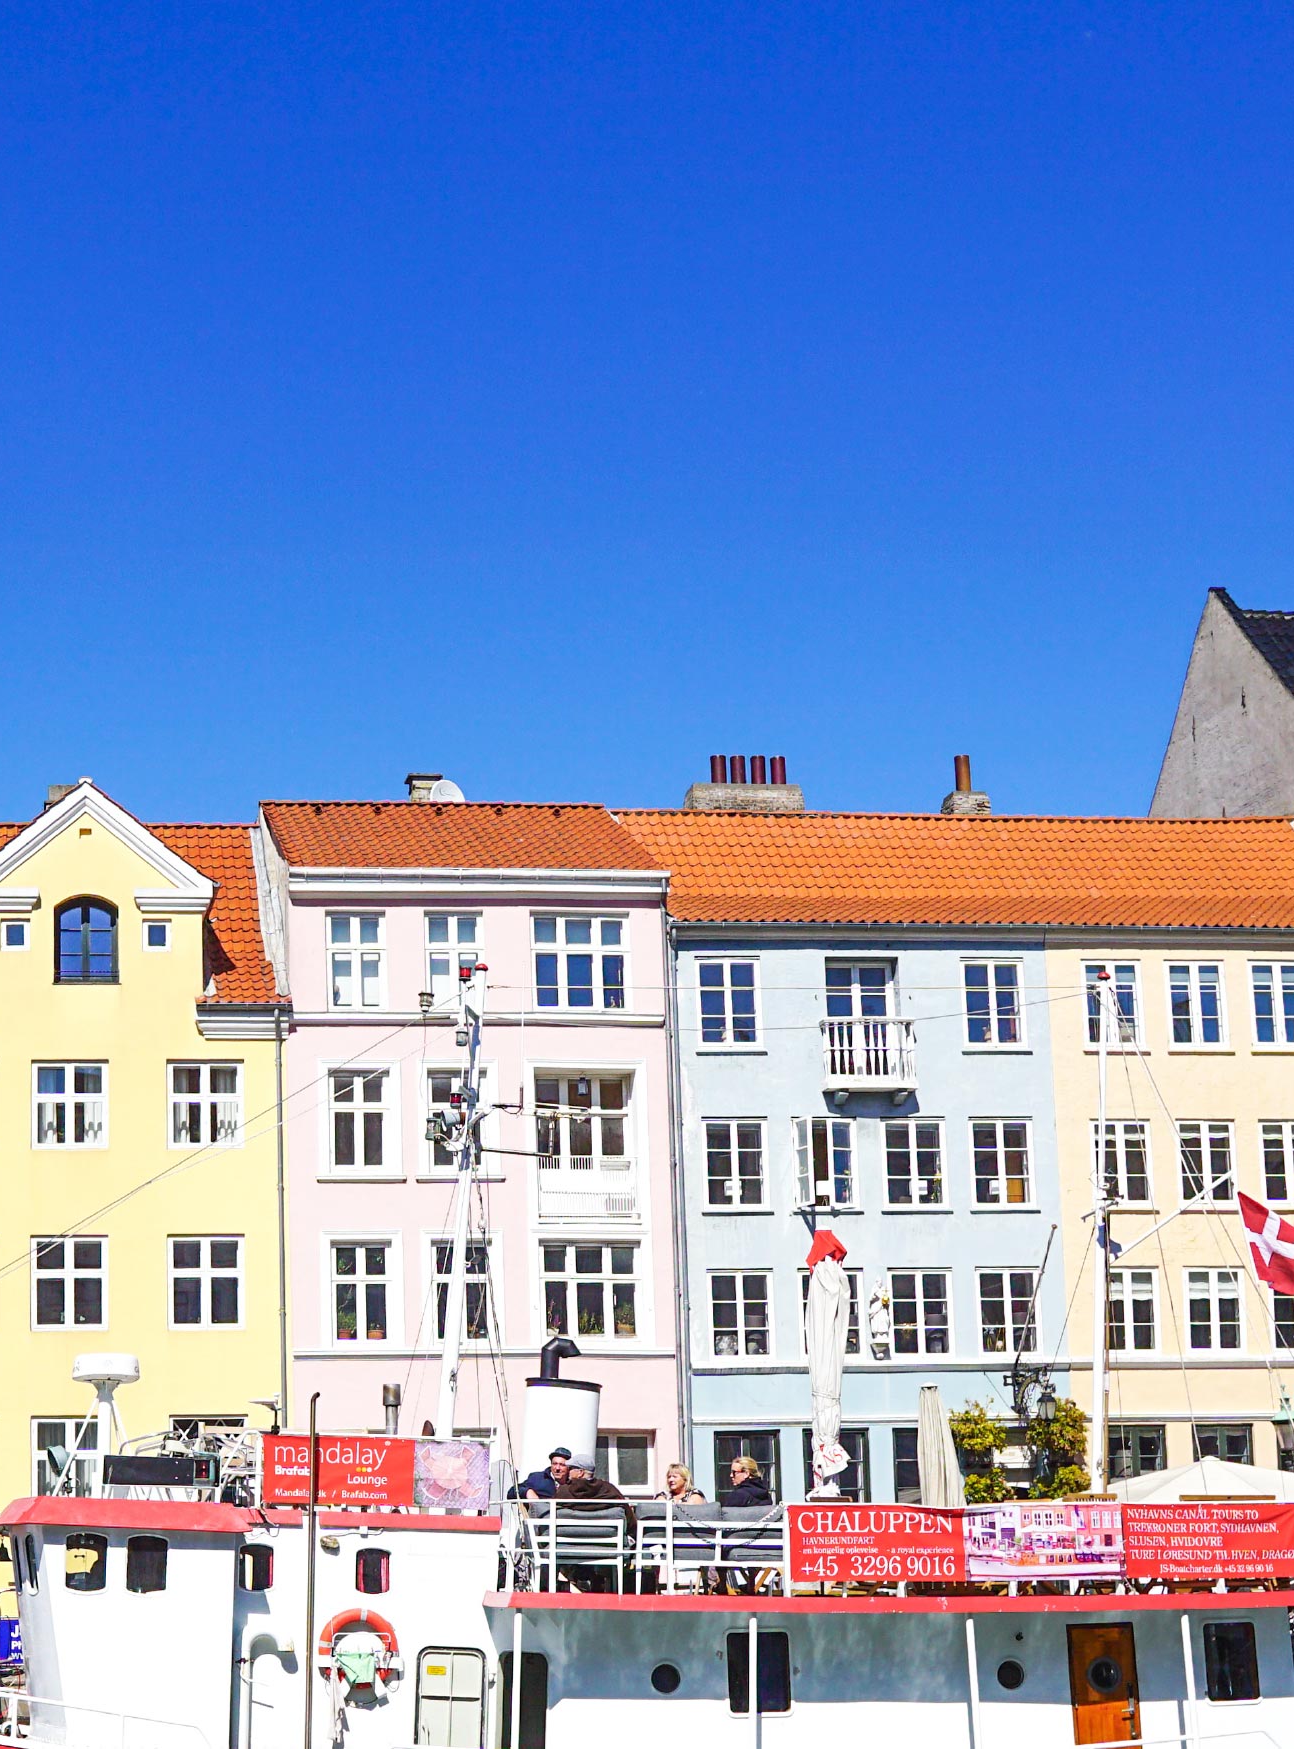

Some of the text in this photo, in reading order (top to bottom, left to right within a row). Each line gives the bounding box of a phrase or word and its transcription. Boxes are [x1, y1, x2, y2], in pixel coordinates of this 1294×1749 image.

[274, 1441, 387, 1470] mandalay
[347, 1473, 388, 1487] Lounge
[341, 1490, 388, 1500] Brafab.com
[1126, 1508, 1259, 1520] NYHAVNS CANAL TOURS TO
[797, 1511, 953, 1534] CHALUPPEN
[1127, 1521, 1280, 1534] TREKRONER FORT, SYDHAVNEN,
[802, 1536, 875, 1546] HAVNERUNDFART
[1128, 1535, 1224, 1548] SLUSEN, HVIDOVRE
[813, 1546, 845, 1556] kongelig
[845, 1546, 879, 1556] oplevelse
[897, 1546, 915, 1556] royal
[916, 1546, 955, 1556] experience
[1129, 1549, 1156, 1560] TURE
[1157, 1549, 1162, 1560] I
[1163, 1549, 1212, 1560] ØRESUND
[1213, 1549, 1230, 1560] TIL
[1231, 1549, 1260, 1561] HVEN,
[801, 1555, 956, 1577] +45 3296 9016
[1160, 1563, 1223, 1574] JS-Boatcharter.dk
